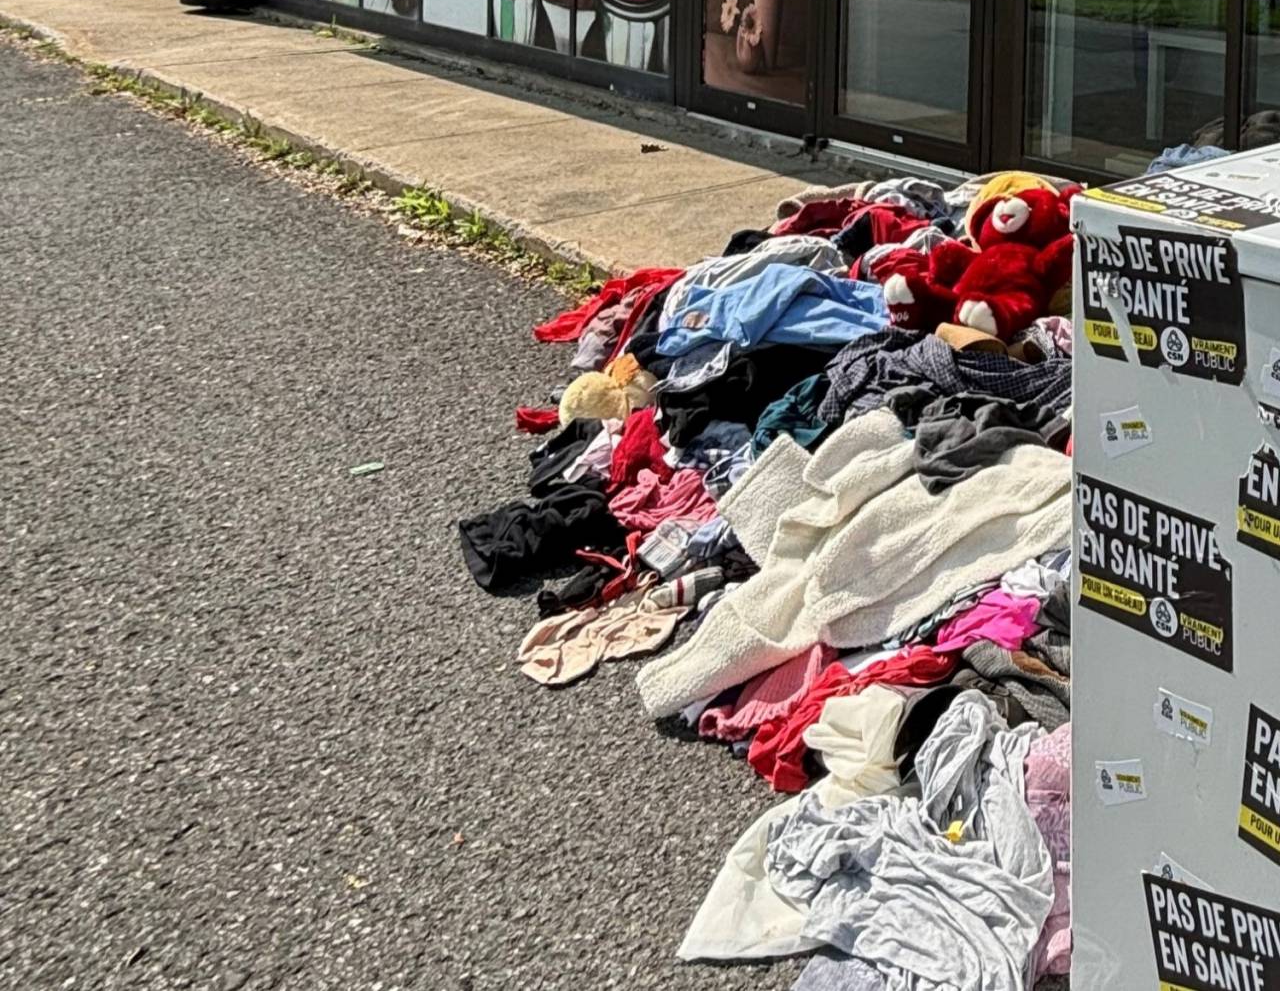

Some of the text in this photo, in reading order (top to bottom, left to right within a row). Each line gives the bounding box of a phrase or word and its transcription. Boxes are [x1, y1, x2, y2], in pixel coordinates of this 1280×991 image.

[1115, 184, 1156, 196] EN
[1145, 176, 1234, 202] PAS DE
[1083, 236, 1231, 284] PAS DE PRIVÉ
[1119, 278, 1190, 325] SANTÉ
[1093, 323, 1112, 339] POUR
[1167, 352, 1184, 362] CSN
[1193, 339, 1236, 357] VRAIMENT
[1195, 352, 1235, 372] PUBLIC
[1247, 459, 1279, 506] EN
[1078, 482, 1150, 543] PAS DE
[1248, 514, 1272, 535] POUR
[1079, 530, 1180, 599] EN SANTÉ
[1082, 578, 1101, 596] POUR
[1102, 584, 1113, 599] UN
[1155, 621, 1172, 634] CSN
[1181, 614, 1223, 641] VRAIMENT
[1182, 627, 1222, 657] PUBLIC
[1250, 813, 1274, 840] POUR
[1150, 883, 1195, 932] PAS
[1197, 897, 1230, 943] DE
[1158, 930, 1264, 991] EN SANTÉ
